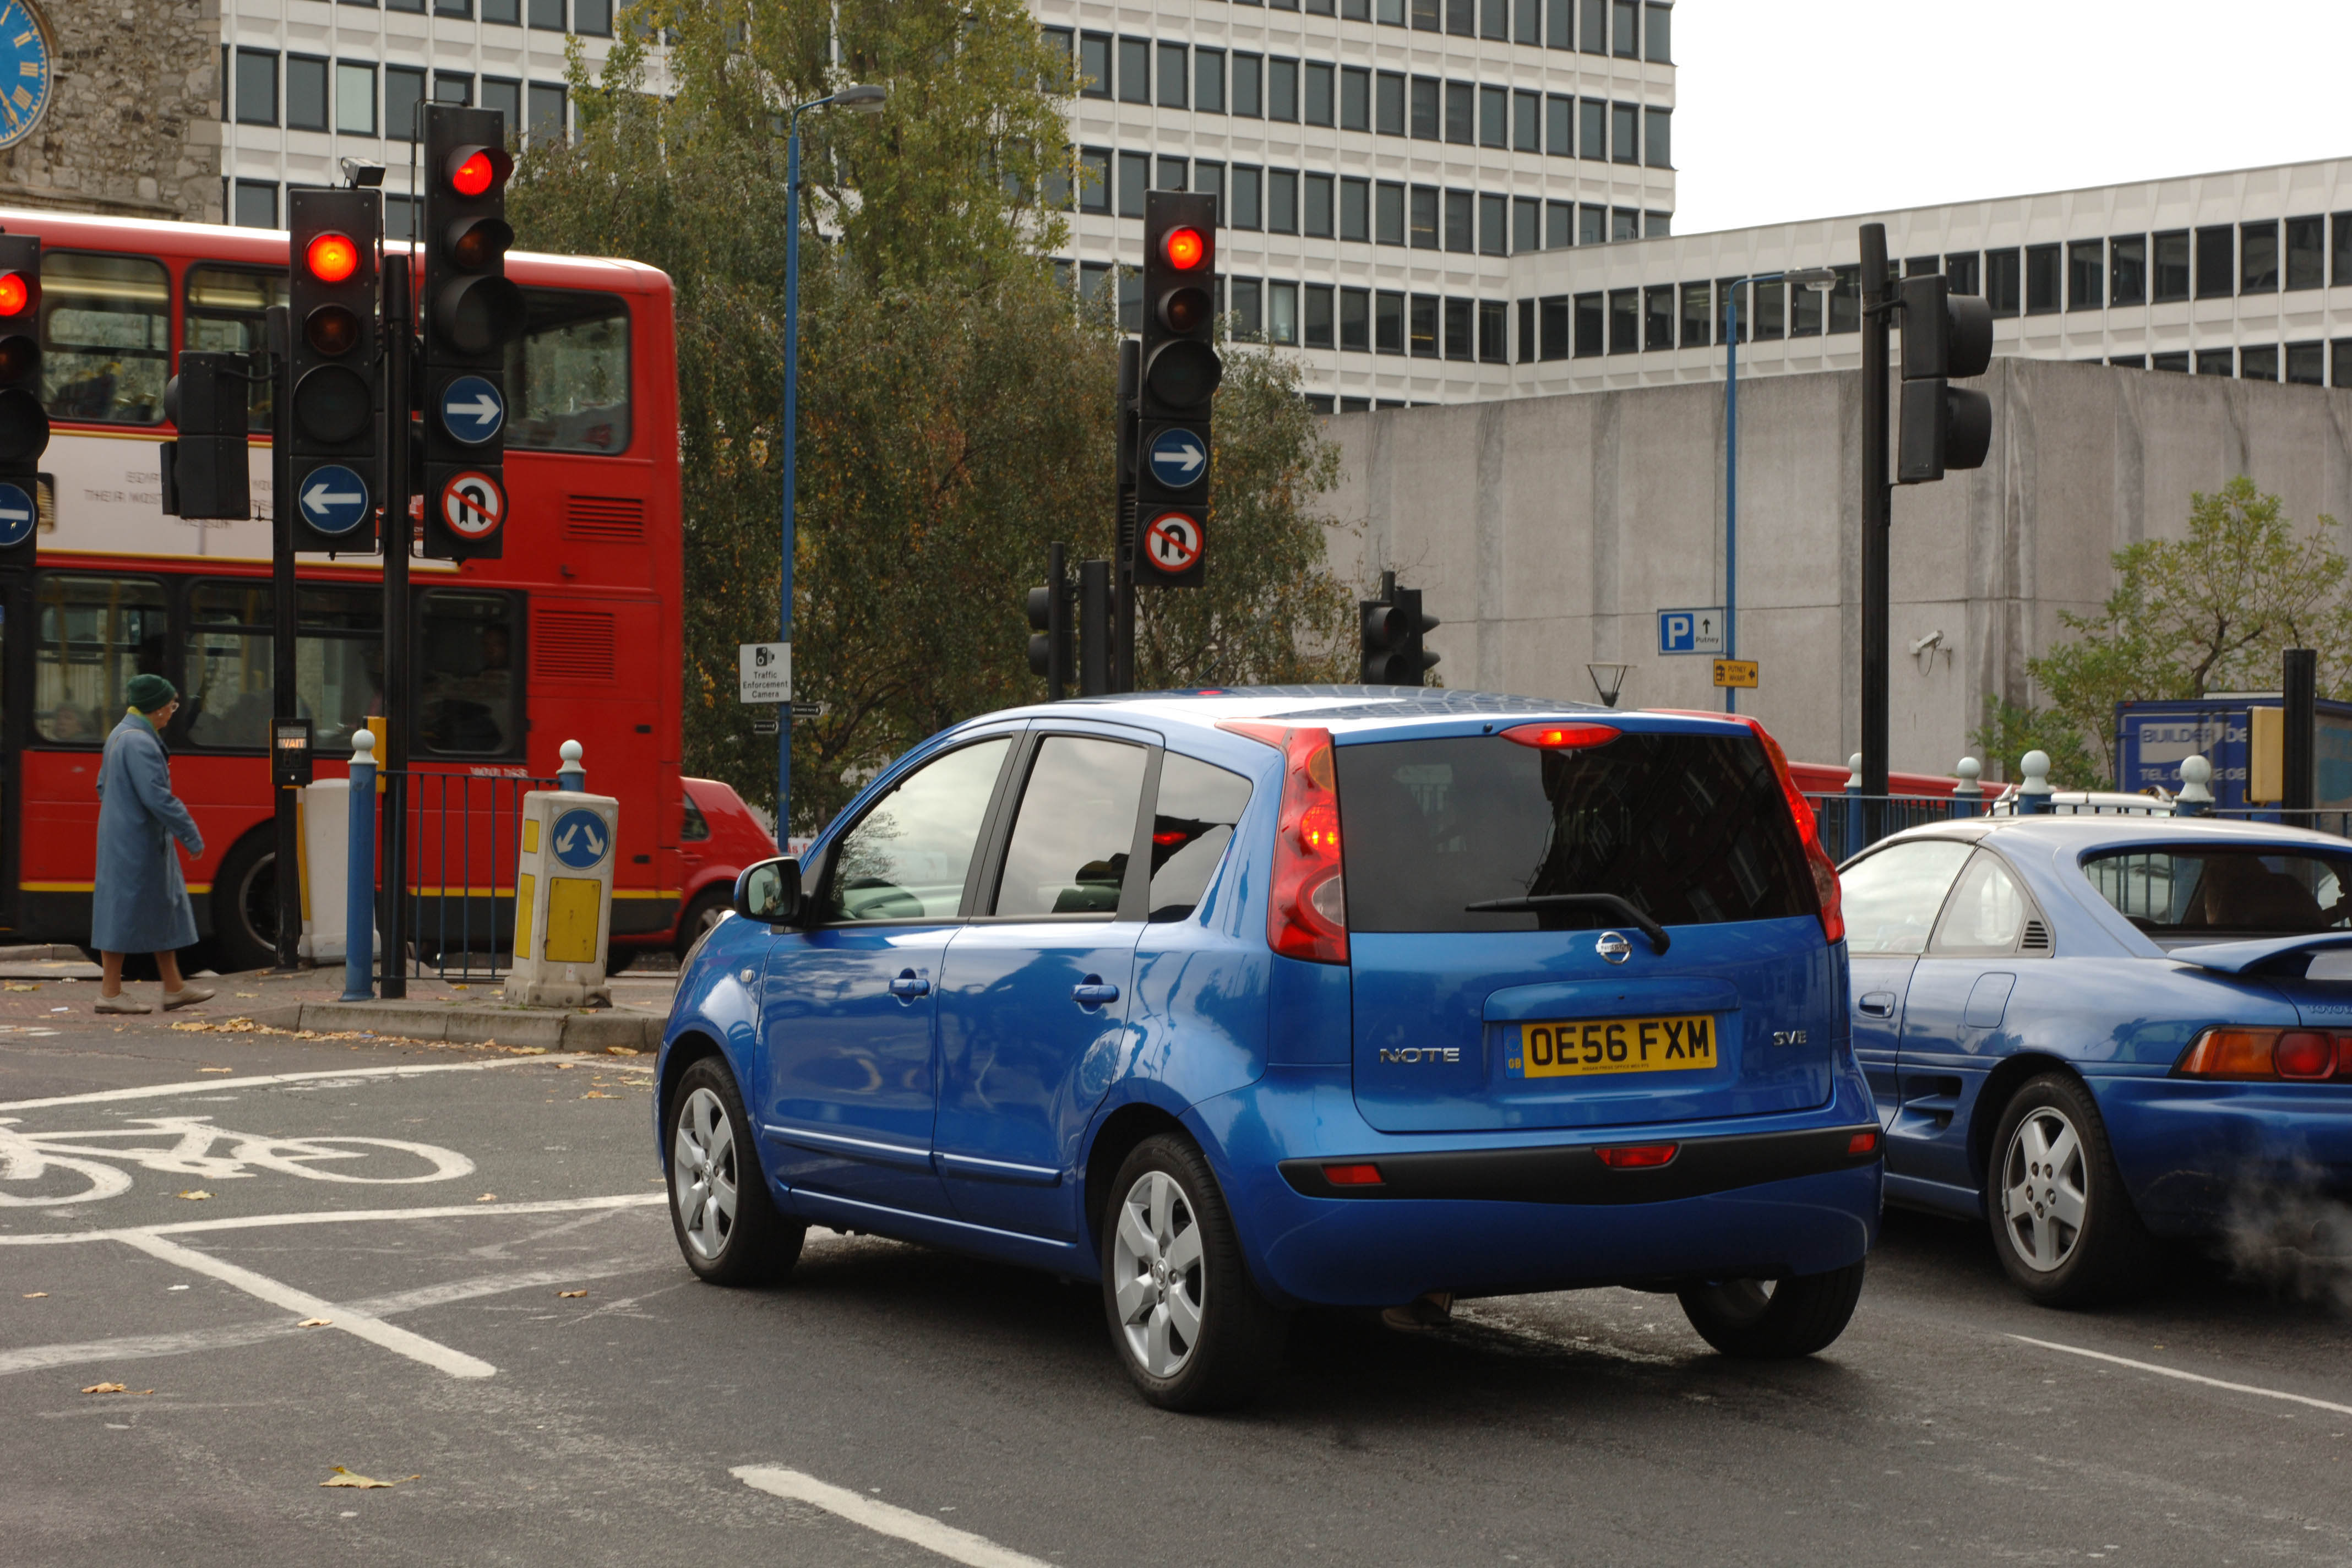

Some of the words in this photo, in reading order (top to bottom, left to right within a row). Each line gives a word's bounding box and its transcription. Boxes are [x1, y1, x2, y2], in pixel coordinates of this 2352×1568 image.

[1668, 616, 1690, 648] P
[1695, 636, 1719, 644] Putney
[743, 680, 788, 689] Enforcement
[279, 738, 304, 748] WAIT
[2307, 1004, 2352, 1014] TOYOT
[1531, 1024, 1627, 1066] OE56
[1638, 1020, 1709, 1060] FXM
[1773, 1030, 1807, 1046] SVE
[1380, 1048, 1460, 1063] NOTE
[1508, 1057, 1521, 1069] GB
